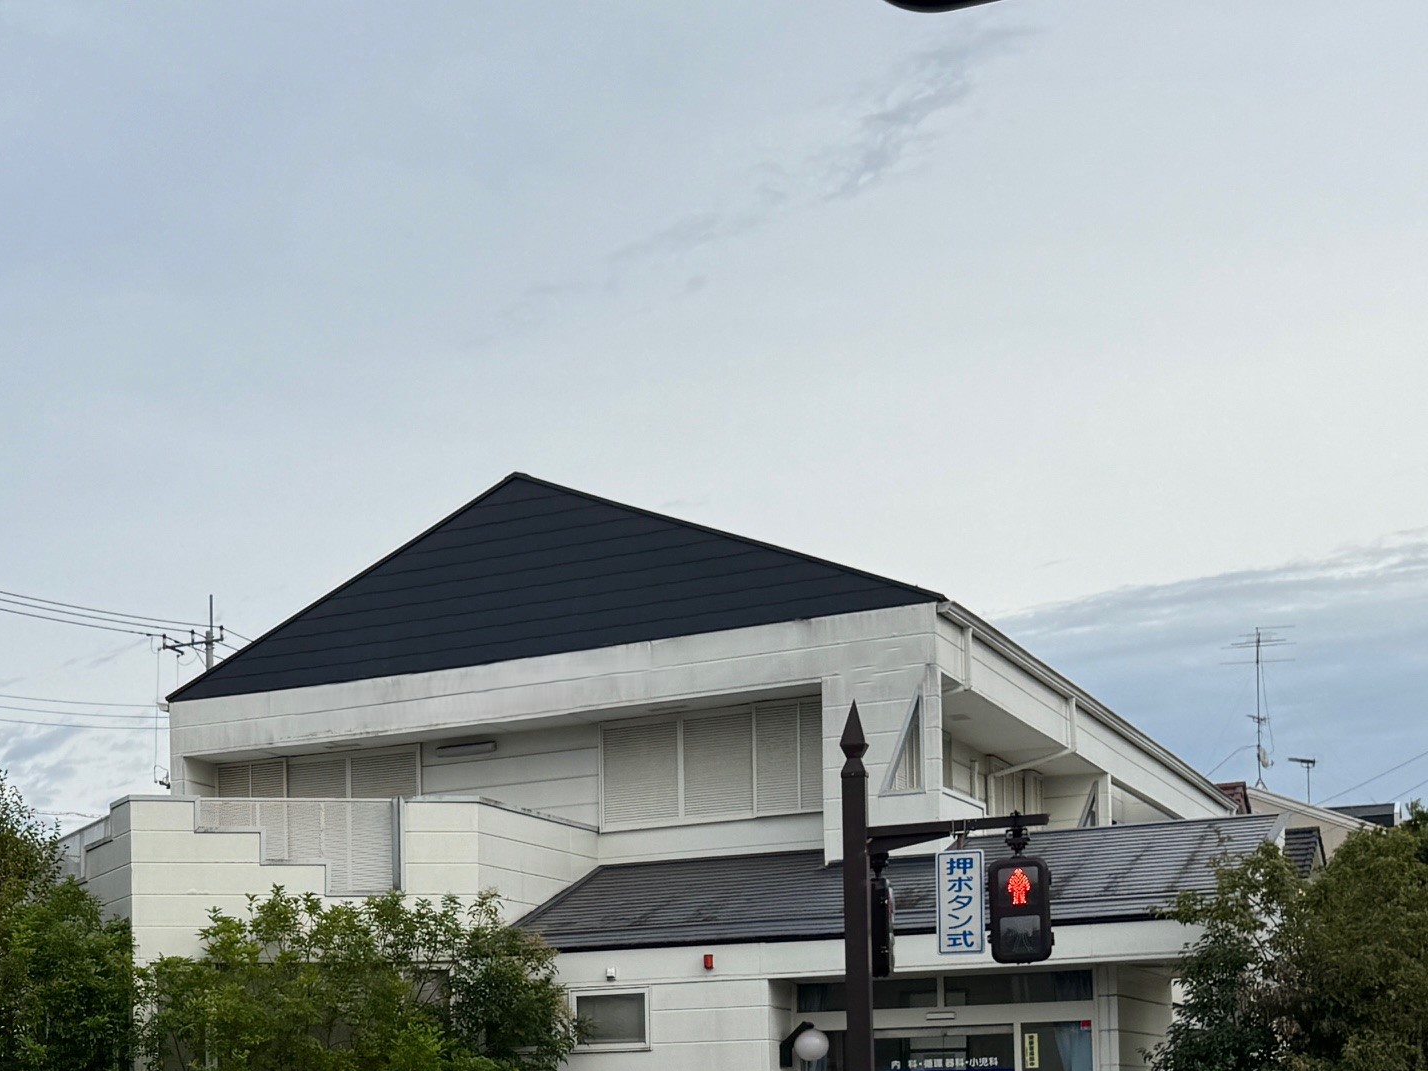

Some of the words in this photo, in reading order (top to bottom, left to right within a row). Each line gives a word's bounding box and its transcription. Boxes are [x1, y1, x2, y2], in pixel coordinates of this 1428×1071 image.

[946, 857, 974, 948] 押ボタン式
